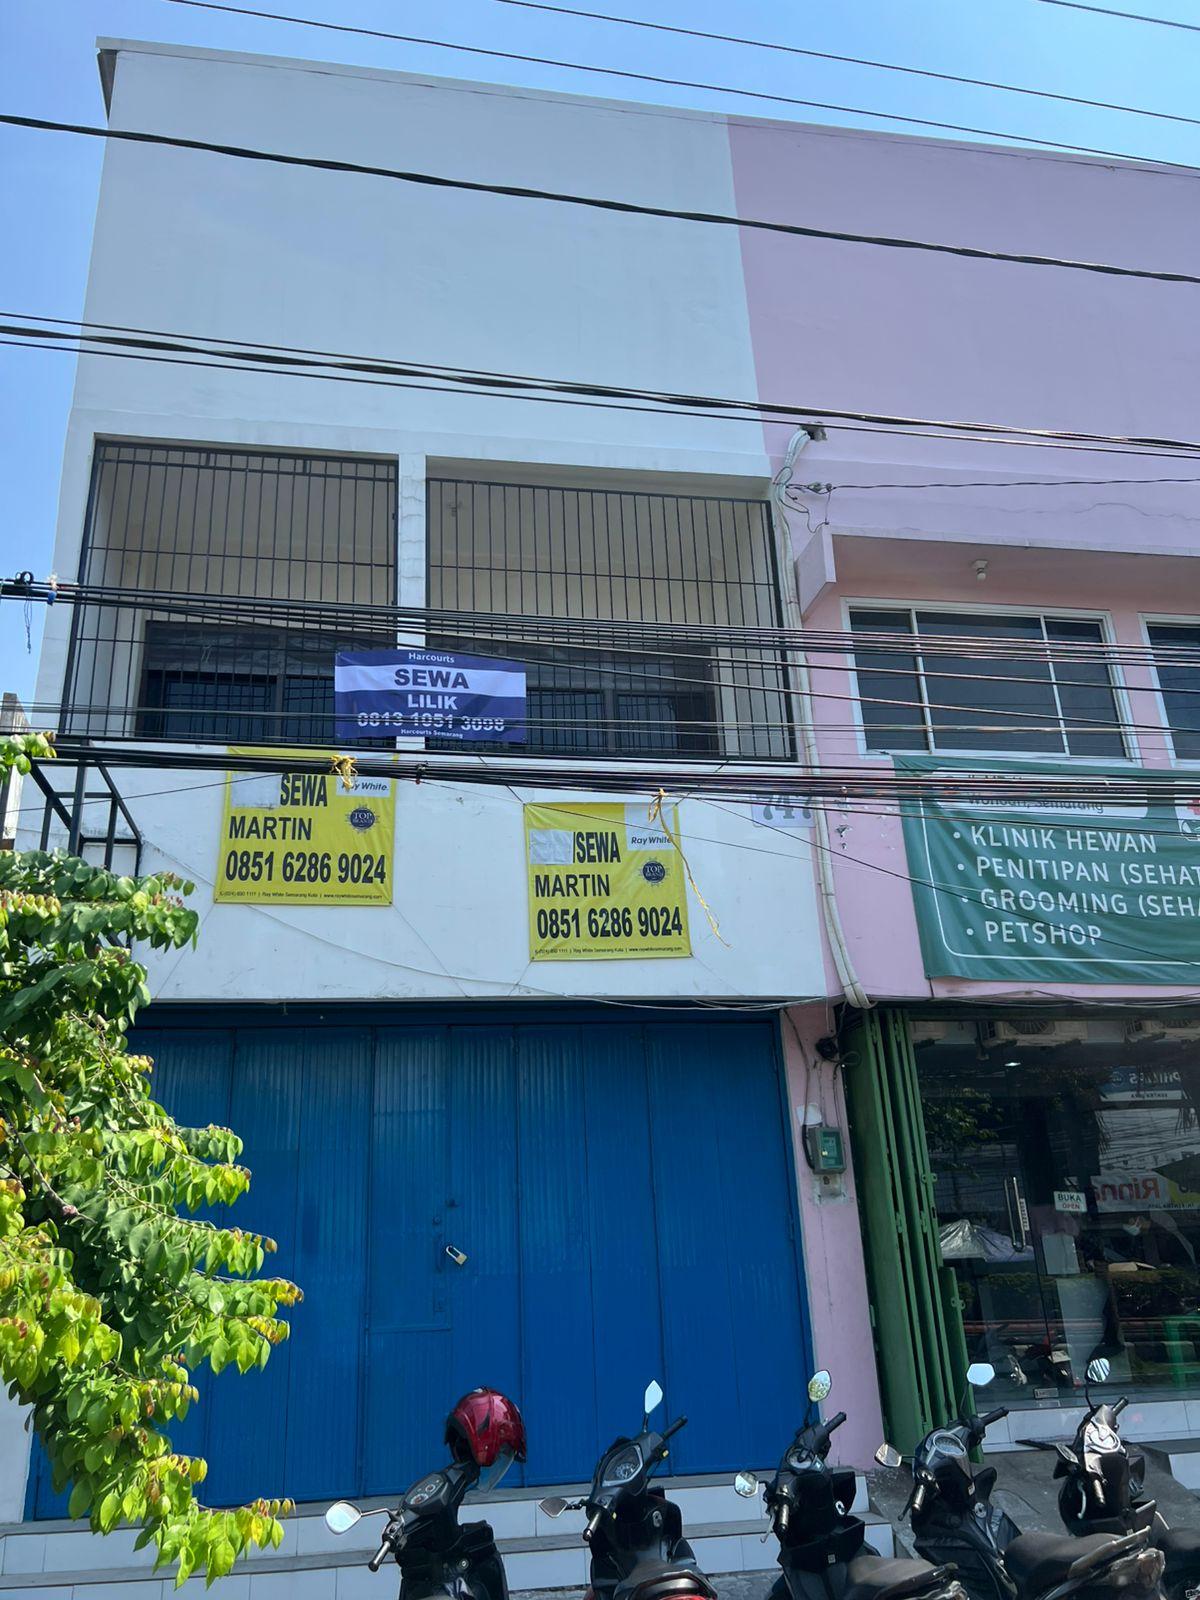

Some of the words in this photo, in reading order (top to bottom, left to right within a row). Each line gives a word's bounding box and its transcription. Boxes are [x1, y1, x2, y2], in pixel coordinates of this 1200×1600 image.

[408, 652, 455, 664] Harcourts
[394, 668, 469, 689] SEWA
[407, 694, 458, 710] LILIK
[433, 730, 463, 739] Semarang
[280, 773, 328, 807] SEWA
[361, 782, 388, 791] White
[229, 815, 312, 840] MARTIN
[971, 825, 1057, 850] KLINIK
[1066, 829, 1158, 854] HEWAN
[631, 836, 648, 846] Ray
[649, 836, 672, 844] White
[225, 850, 274, 881] 0851
[282, 851, 331, 883] 6286
[338, 853, 386, 884] 9024
[976, 856, 1110, 883] PENITIPAN
[535, 874, 610, 898] MARTIN
[980, 888, 1128, 915] GROOMING
[1138, 894, 1200, 918] (SEH
[537, 908, 580, 939] 0851
[588, 907, 633, 938] 6286
[638, 906, 683, 937] 9024
[984, 920, 1102, 946] PETSHOP
[1057, 1193, 1081, 1202] BUKA
